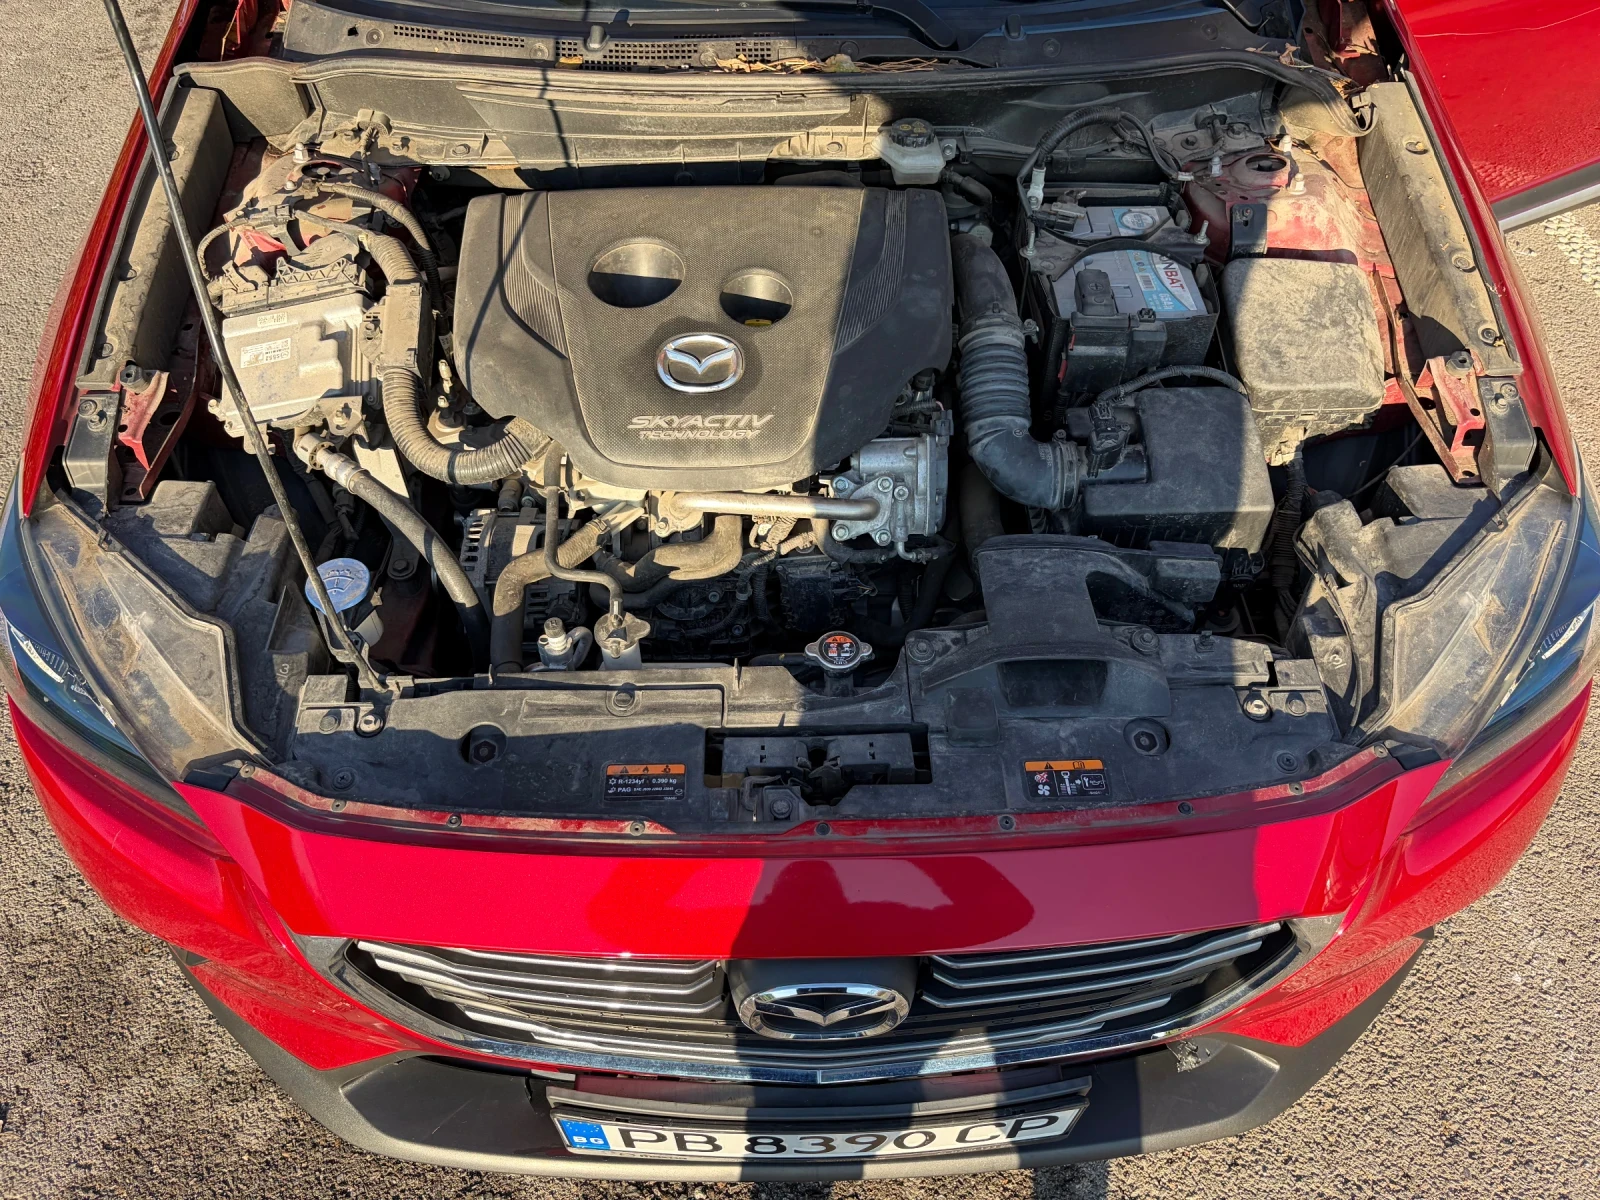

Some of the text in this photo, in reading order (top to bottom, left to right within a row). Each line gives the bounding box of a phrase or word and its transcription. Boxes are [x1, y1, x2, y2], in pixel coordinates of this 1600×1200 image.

[627, 414, 775, 429] SKYACTIV
[638, 429, 761, 440] TECHNOLOGY
[572, 1135, 604, 1145] BG
[618, 1115, 1059, 1155] PB 8390 CP
